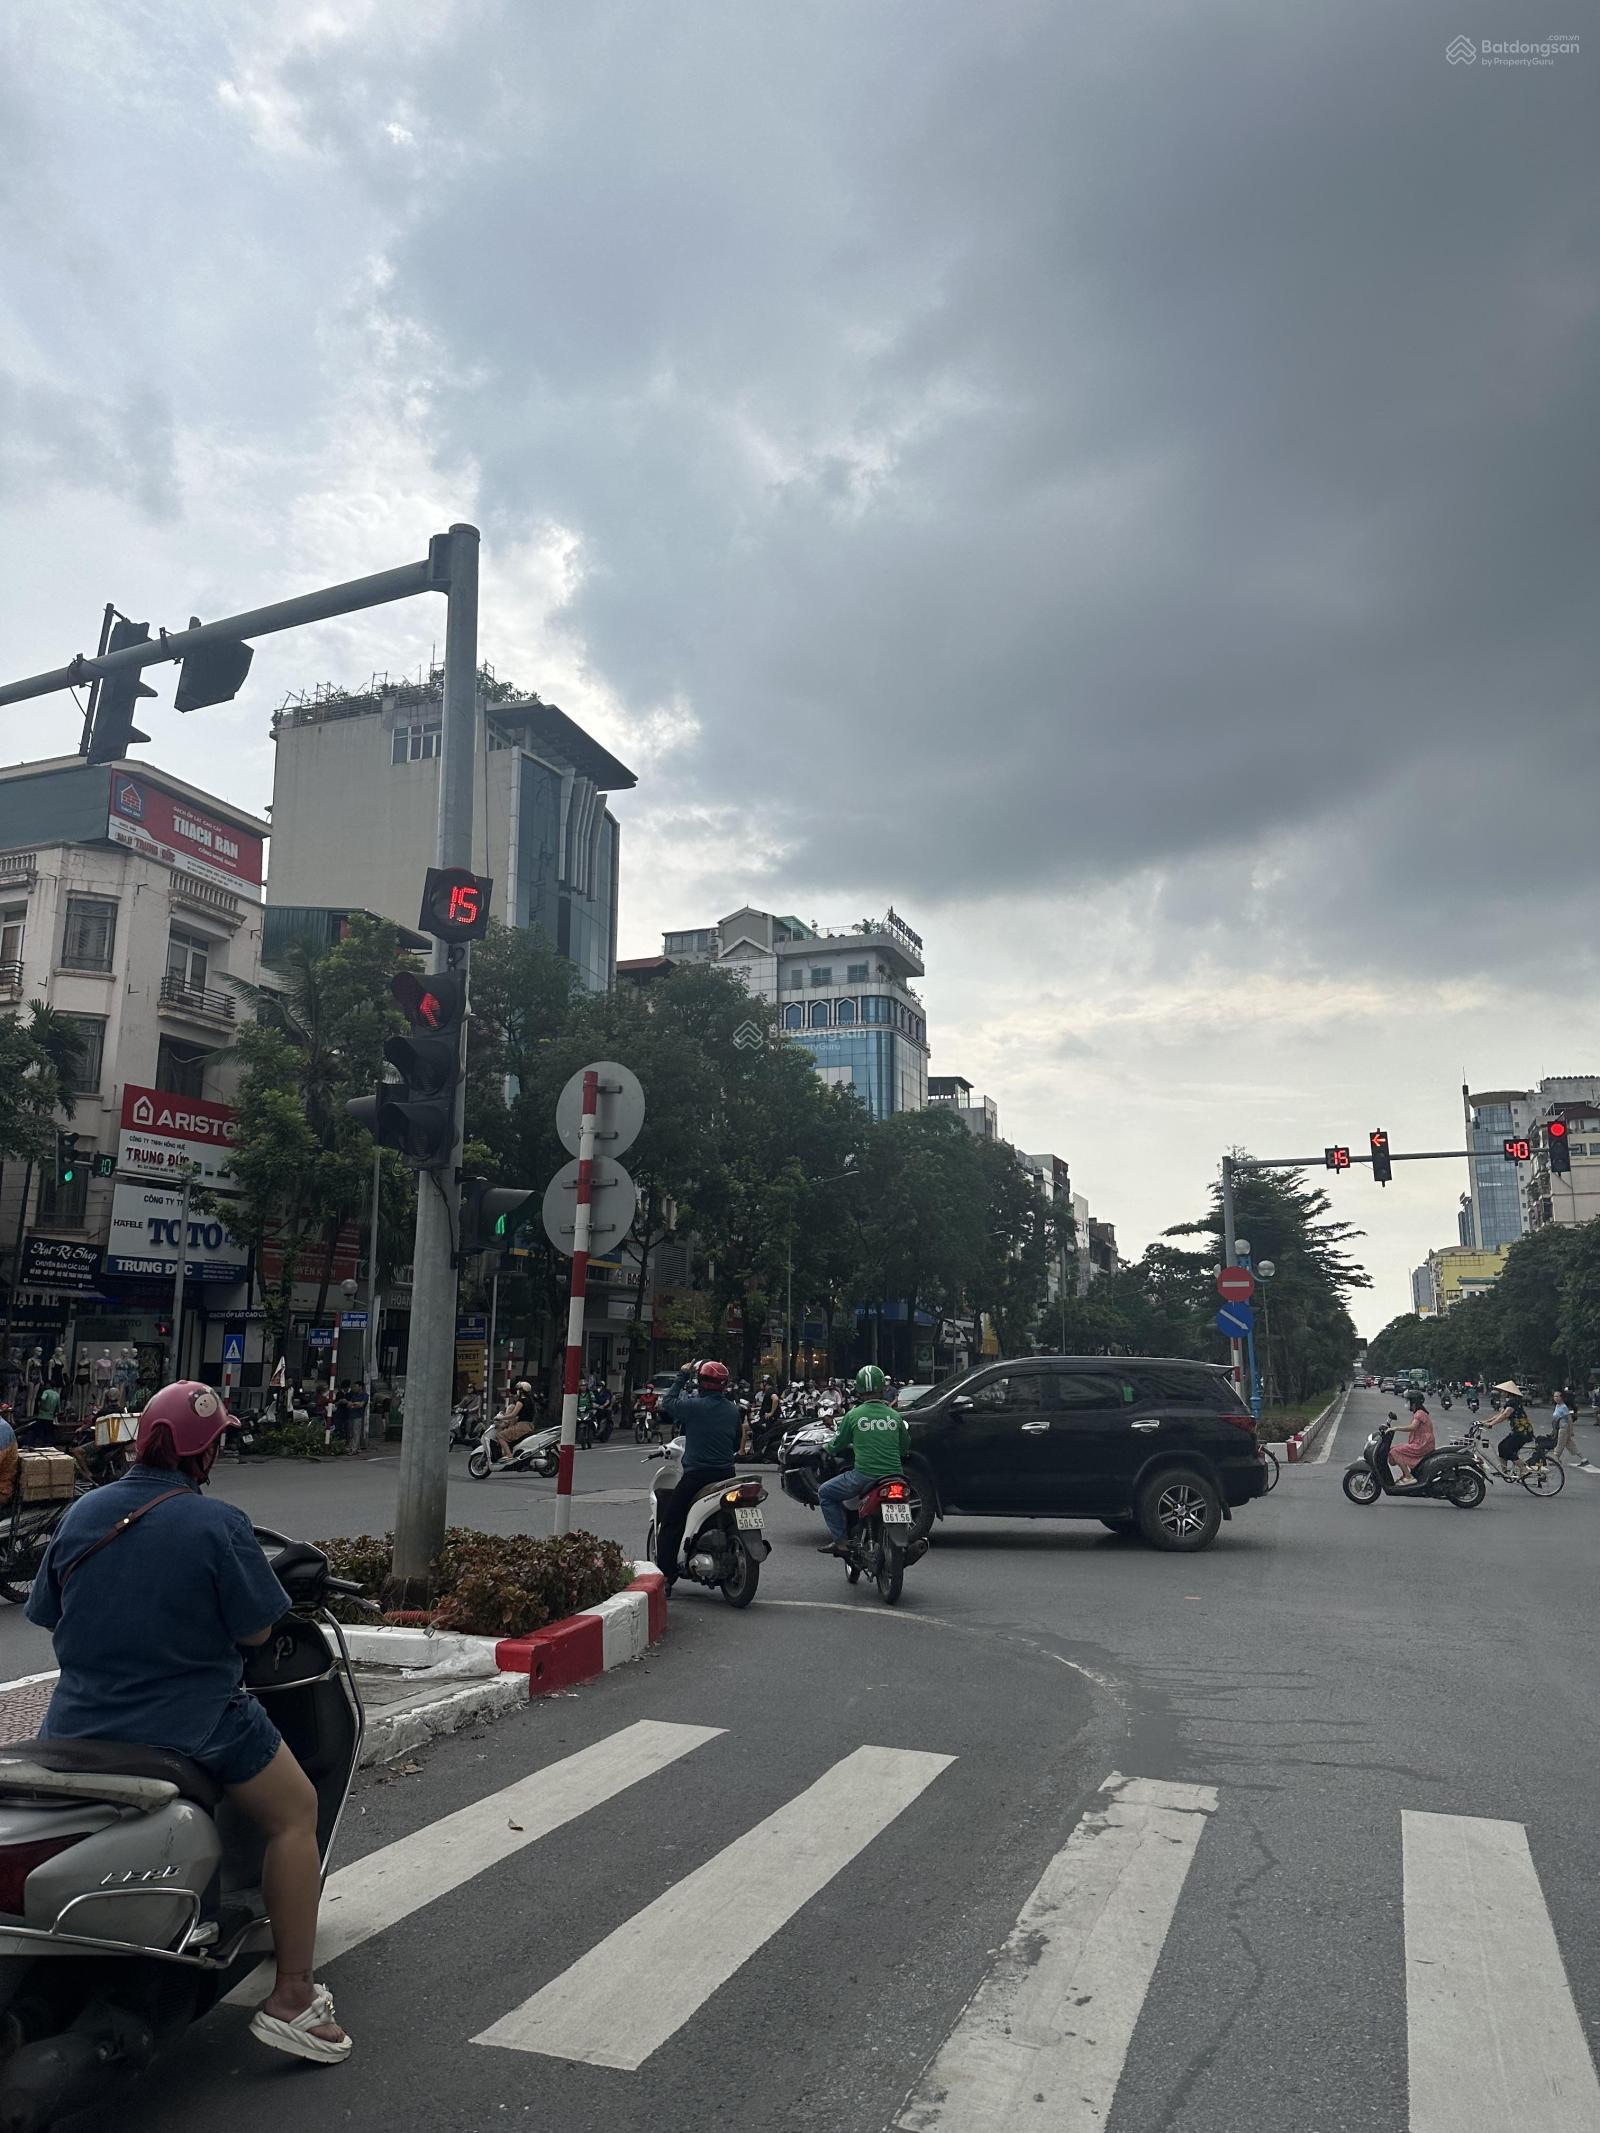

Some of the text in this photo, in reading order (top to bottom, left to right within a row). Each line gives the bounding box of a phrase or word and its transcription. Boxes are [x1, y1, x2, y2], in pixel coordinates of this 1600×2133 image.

[173, 814, 238, 859] THẠCH BÀN
[449, 886, 478, 924] 15
[156, 1109, 240, 1139] ARISTO
[126, 1147, 164, 1164] TRUNG
[1333, 1150, 1349, 1166] 15
[1505, 1141, 1528, 1159] 40
[144, 1194, 163, 1204] CÔNG
[148, 1218, 223, 1249] TOTO
[72, 1247, 97, 1263] Shop
[115, 1260, 162, 1273] TRUNG
[165, 1264, 193, 1275] ĐC
[628, 1273, 650, 1286] BOSH
[857, 1416, 897, 1431] Grab
